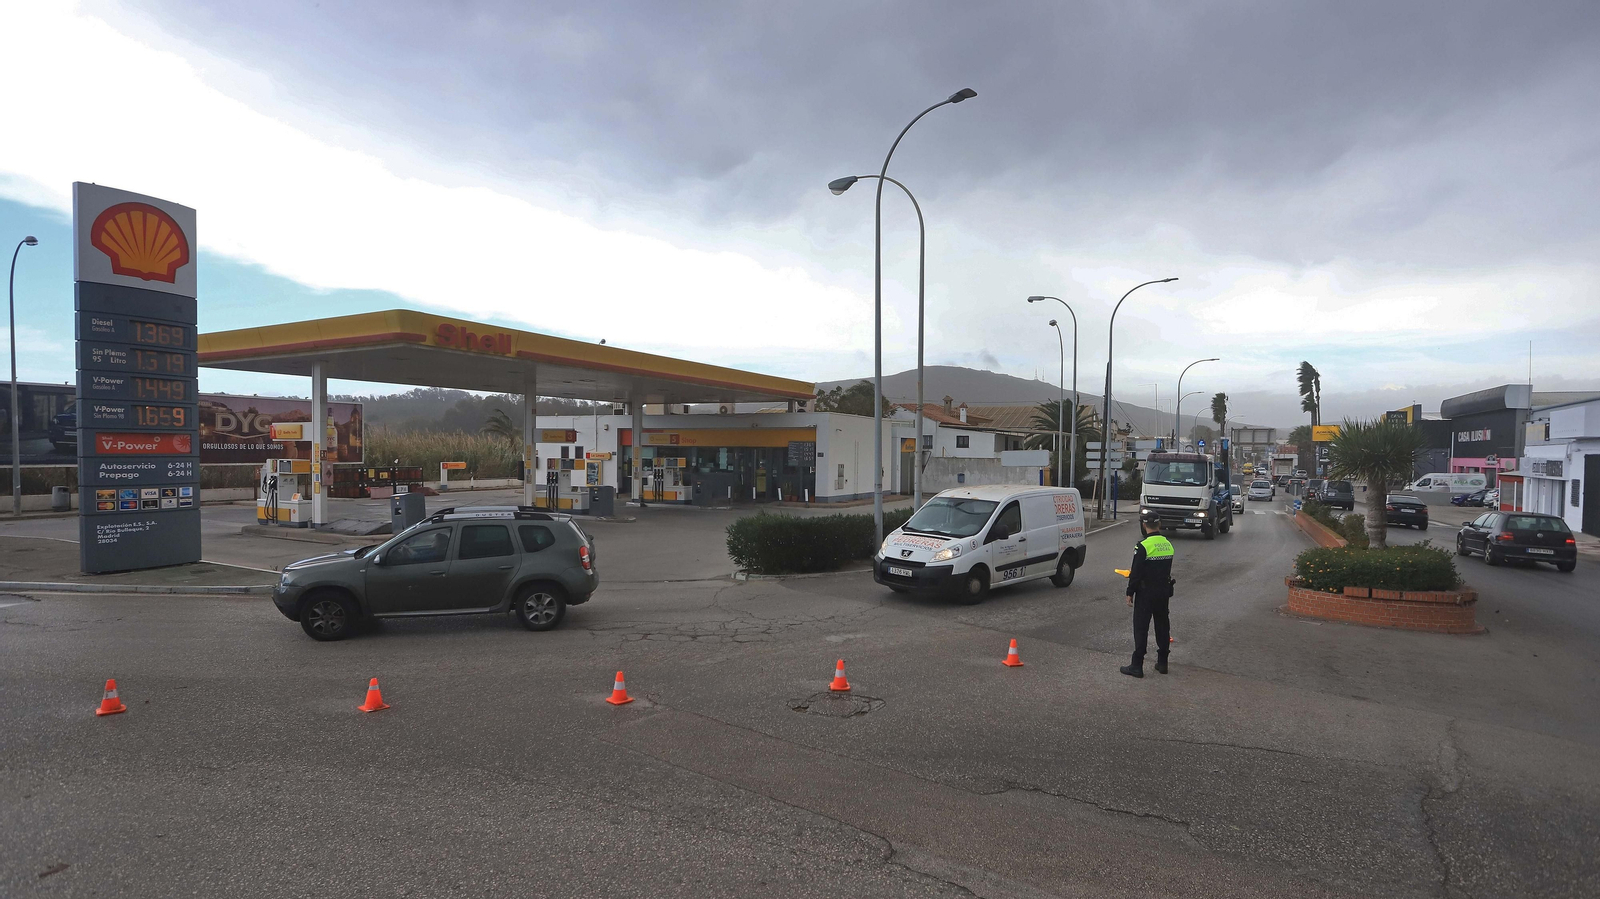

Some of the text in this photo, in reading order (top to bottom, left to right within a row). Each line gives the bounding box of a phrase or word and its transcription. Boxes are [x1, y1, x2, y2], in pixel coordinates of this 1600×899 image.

[92, 318, 113, 326] Diesel
[438, 323, 511, 354] Shell
[105, 349, 126, 357] Plomo
[567, 432, 573, 440] 3
[1458, 431, 1470, 442] CASA
[102, 441, 158, 450] V-Power
[100, 462, 156, 470] Autoservicio
[99, 472, 139, 480] Prepago
[1003, 568, 1017, 580] 956
